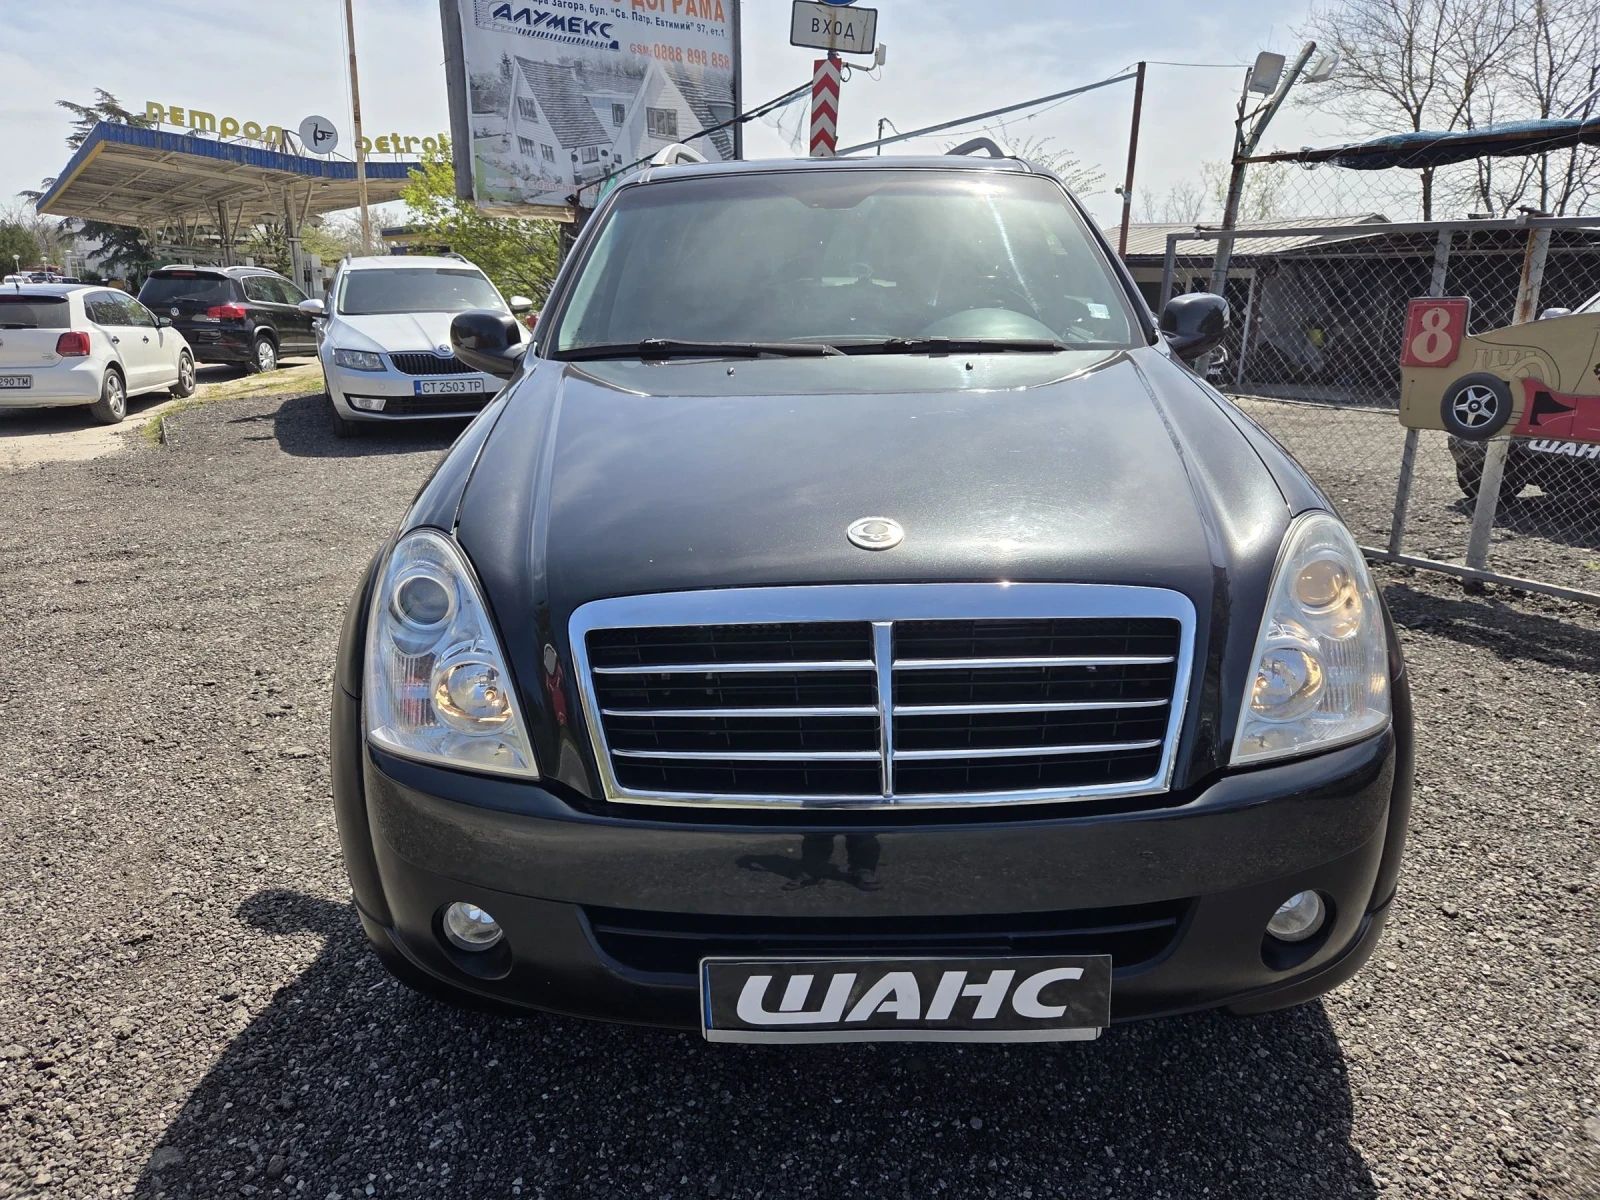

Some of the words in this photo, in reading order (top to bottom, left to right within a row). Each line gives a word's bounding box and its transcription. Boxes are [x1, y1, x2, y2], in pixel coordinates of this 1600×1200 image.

[492, 3, 613, 39] АЛУМЕКС
[589, 4, 608, 16] бул.
[631, 11, 653, 25] Патр.
[811, 17, 856, 41] ВХОД
[653, 43, 683, 63] 0888
[687, 48, 708, 65] 898
[711, 52, 730, 69] 858
[1411, 307, 1453, 363] 8
[422, 382, 437, 394] CT
[439, 381, 466, 393] 2503
[467, 381, 481, 392] TP
[1528, 439, 1600, 459] ШАН
[736, 967, 1085, 1025] ШАНС
